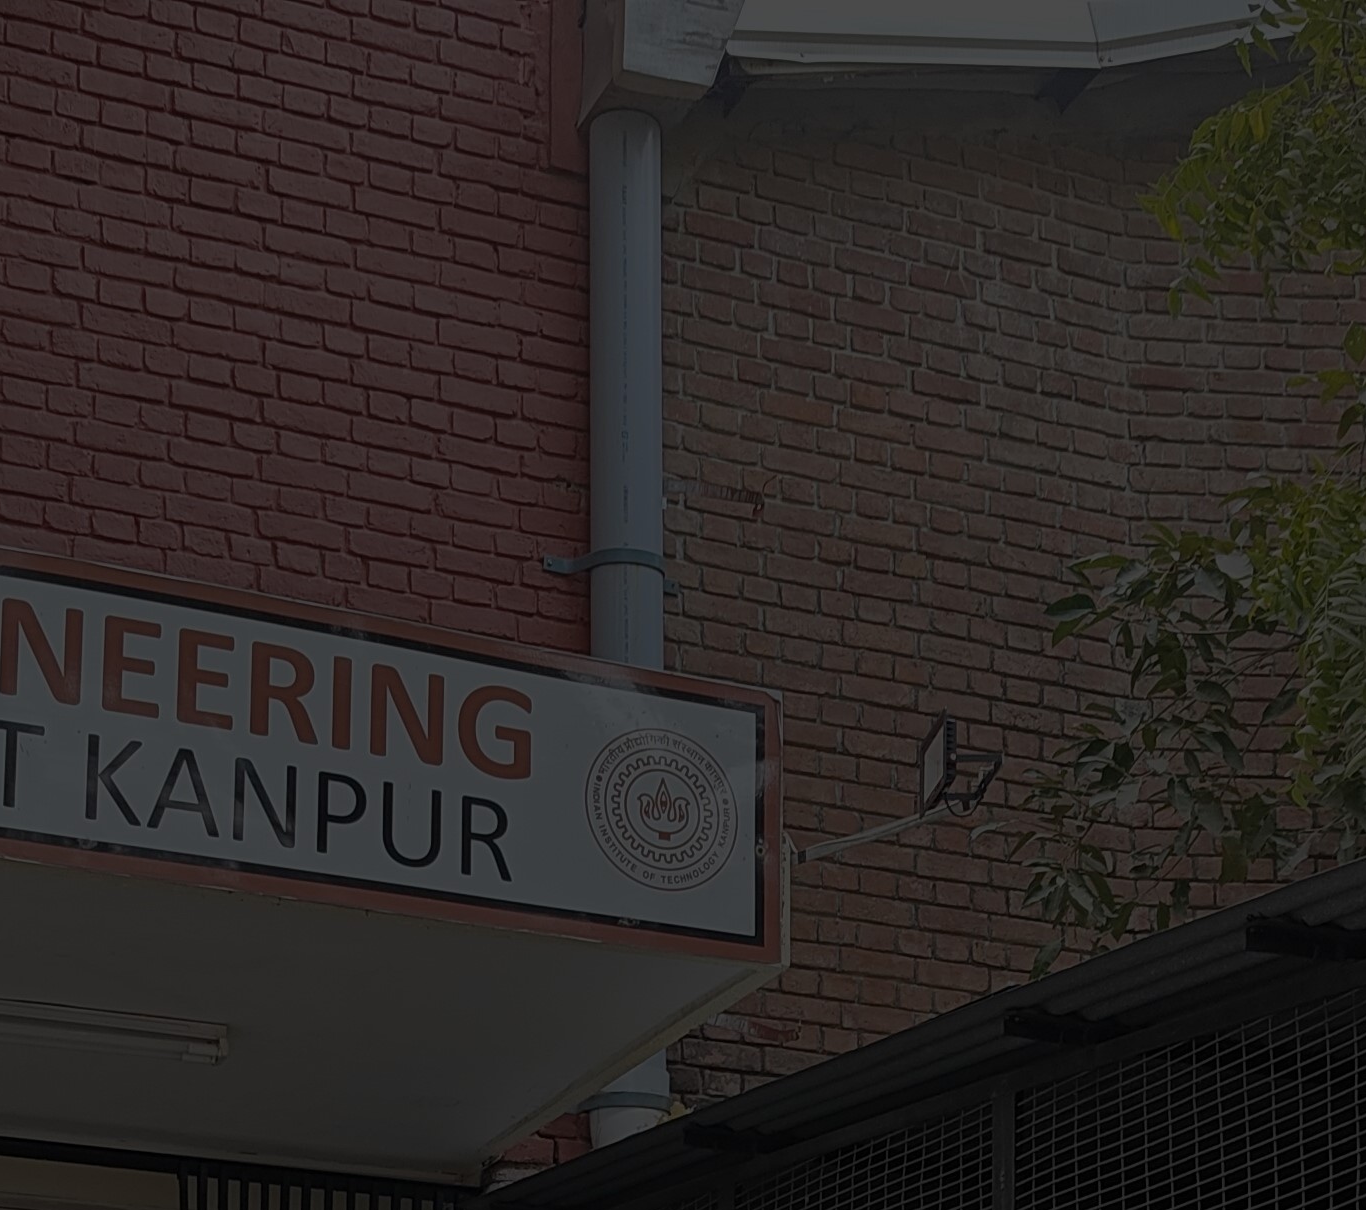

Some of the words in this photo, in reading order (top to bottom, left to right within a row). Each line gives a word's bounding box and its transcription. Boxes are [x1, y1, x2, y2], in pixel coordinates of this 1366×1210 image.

[83, 733, 513, 881] KANPUR
[592, 782, 603, 820] INDIAN
[598, 824, 638, 873] INSTITUTE
[642, 870, 656, 881] OF
[660, 851, 720, 885] TECHNOLOGY
[718, 807, 731, 848] KANPUR
